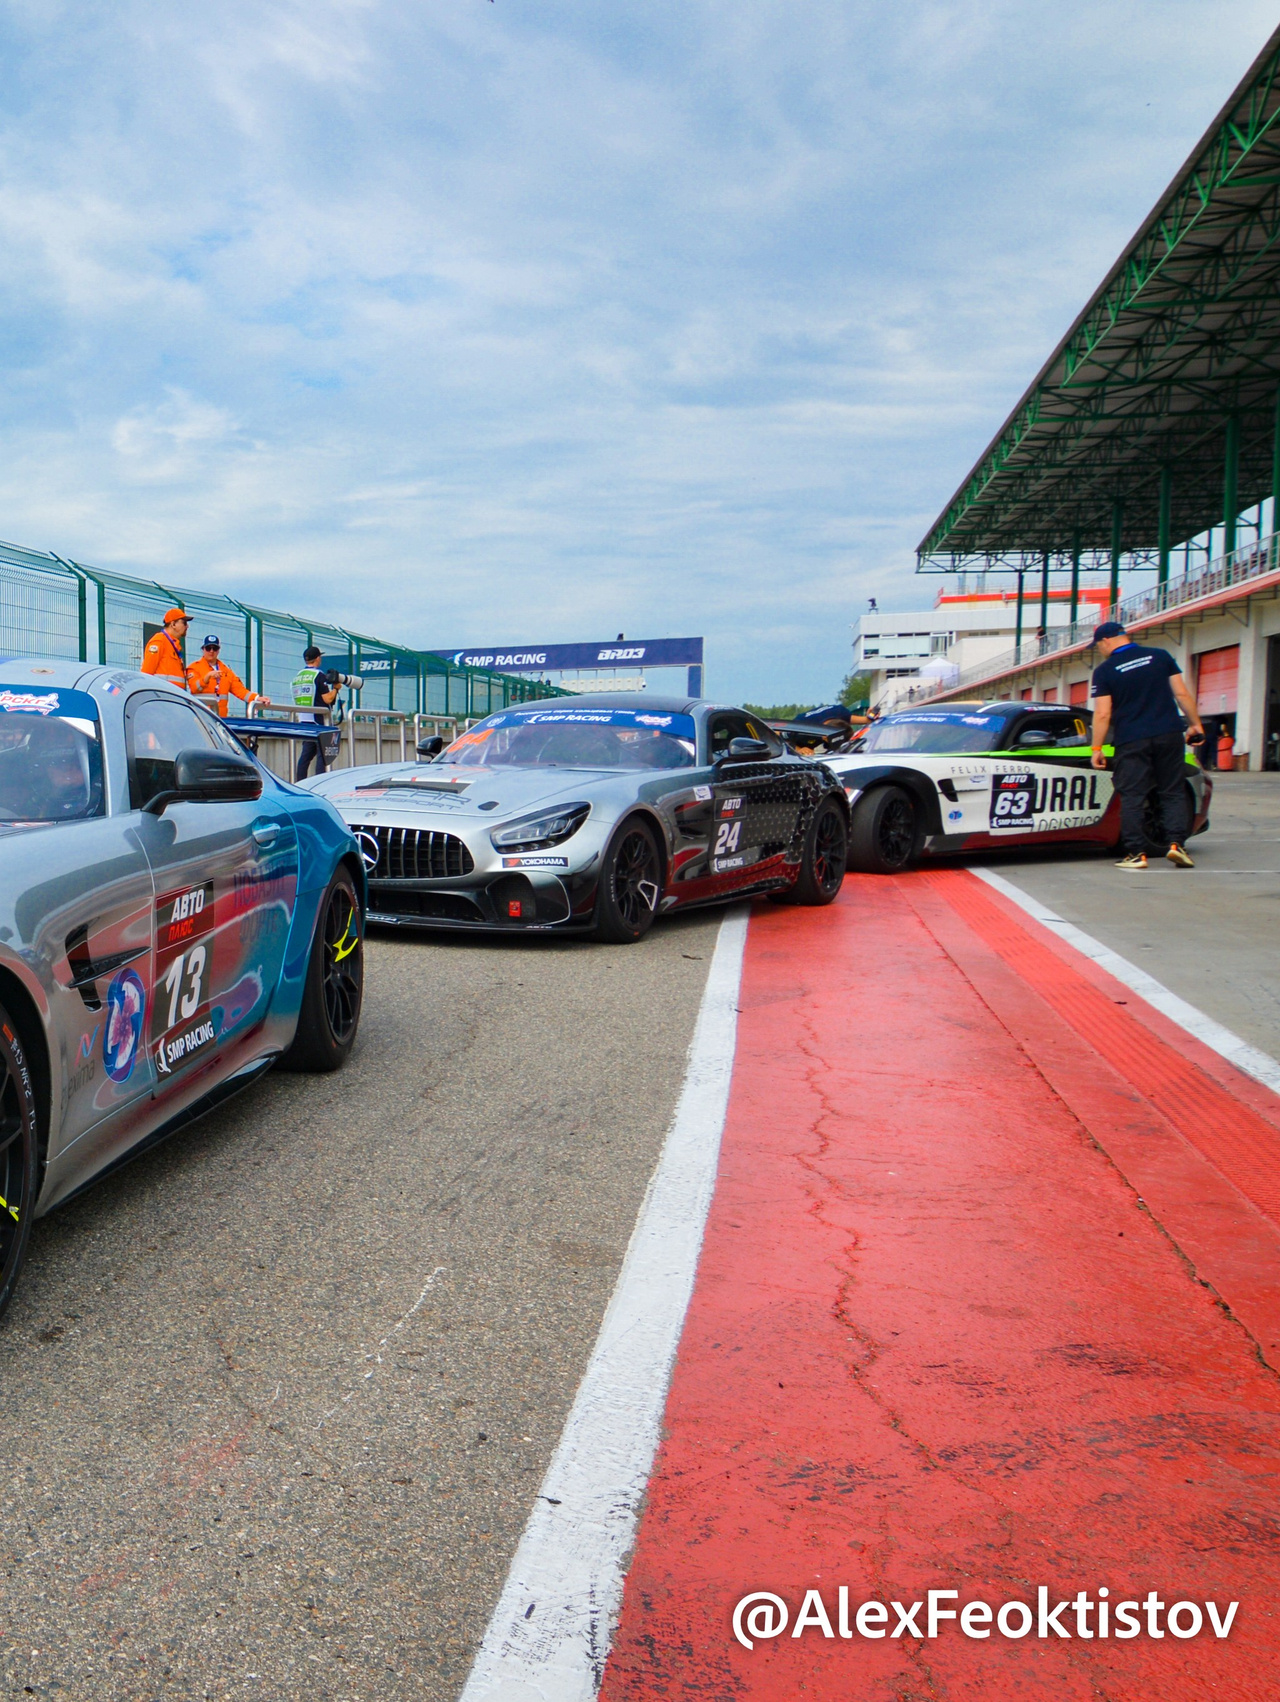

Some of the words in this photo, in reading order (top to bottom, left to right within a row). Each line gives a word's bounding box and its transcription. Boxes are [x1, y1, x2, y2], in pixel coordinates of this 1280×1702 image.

[464, 656, 494, 667] SMP
[495, 653, 546, 666] RACING
[951, 766, 987, 774] FELIX
[995, 765, 1031, 774] FERRO
[1001, 774, 1028, 784] АВТО
[722, 798, 742, 811] АВТО
[995, 791, 1030, 816] 63
[714, 821, 741, 855] 24
[520, 858, 565, 866] YOKOHAMA
[171, 888, 205, 923] АВТО
[168, 919, 195, 942] ПЛЮС
[165, 945, 207, 1028] 13
[166, 1038, 185, 1064] SMP
[185, 1020, 215, 1057] RACING
